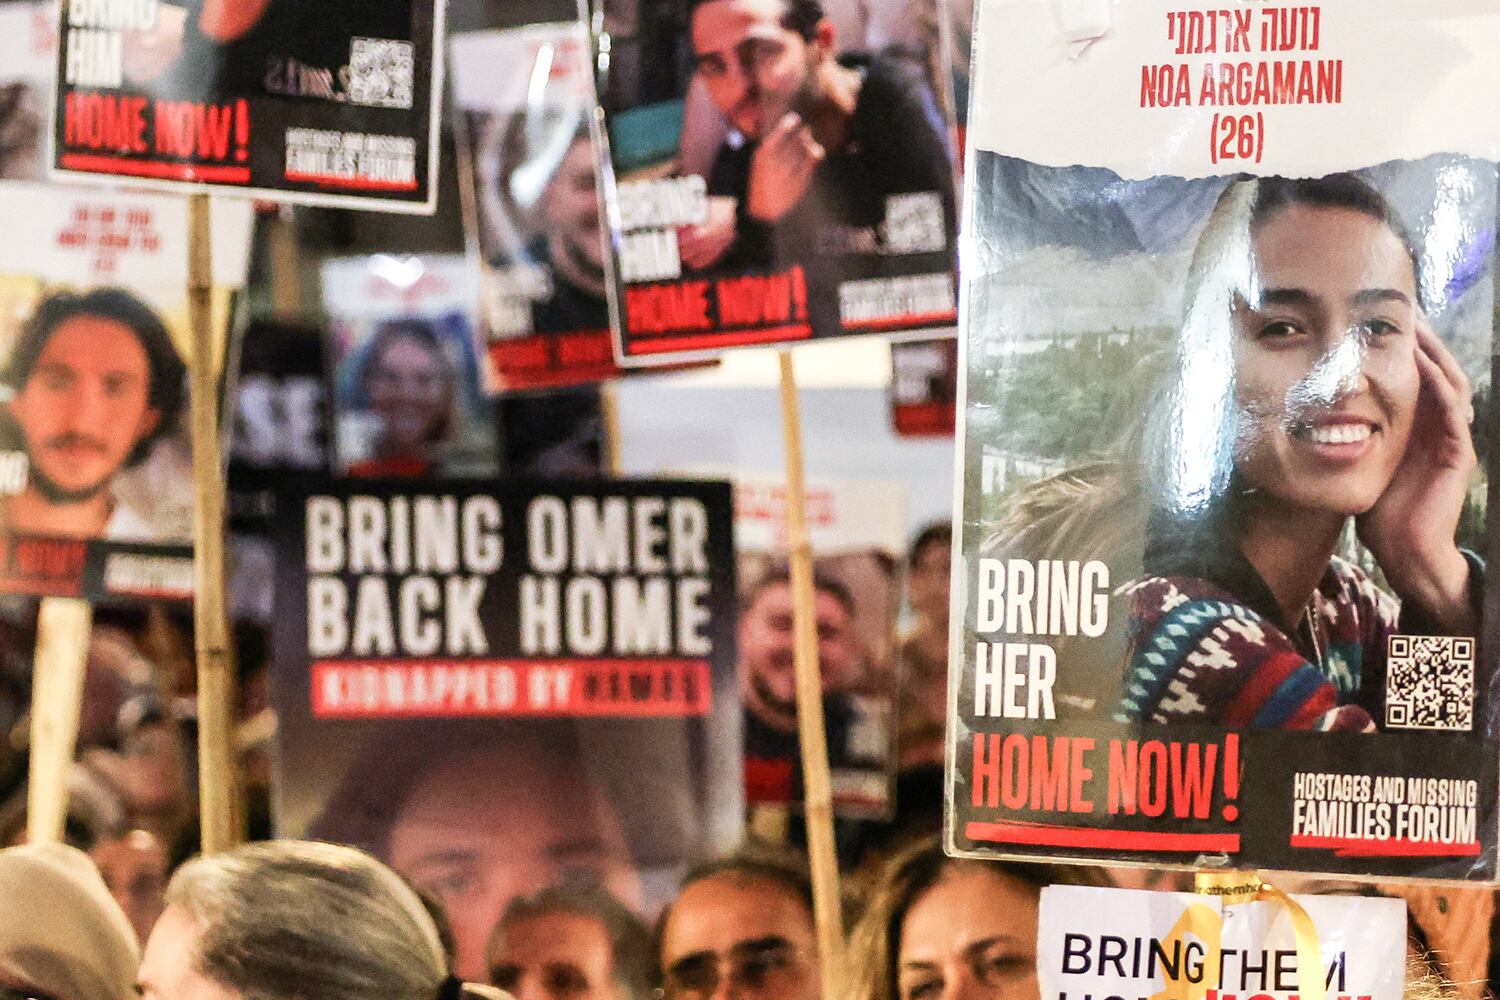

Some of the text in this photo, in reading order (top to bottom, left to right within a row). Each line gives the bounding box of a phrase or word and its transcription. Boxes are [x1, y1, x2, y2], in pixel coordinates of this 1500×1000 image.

[1167, 6, 1320, 55] נועה ארגמני
[1140, 59, 1343, 108] NOA ARGAMANI
[64, 91, 148, 152] HOME
[155, 97, 250, 162] NOW!
[1210, 112, 1264, 164] (26)
[306, 495, 503, 574] BRING
[526, 495, 711, 574] OMER
[307, 574, 713, 657] BACK HOME
[977, 558, 1109, 637] BRING
[323, 664, 517, 711] KIDNAPPED
[525, 664, 574, 711] BY
[975, 643, 1056, 720] HER
[971, 732, 1241, 821] HOME NOW!
[1294, 772, 1477, 808] HOSTAGES AND MISSING
[1292, 801, 1477, 845] FAMILIES FORUM
[1061, 933, 1204, 984] BRING
